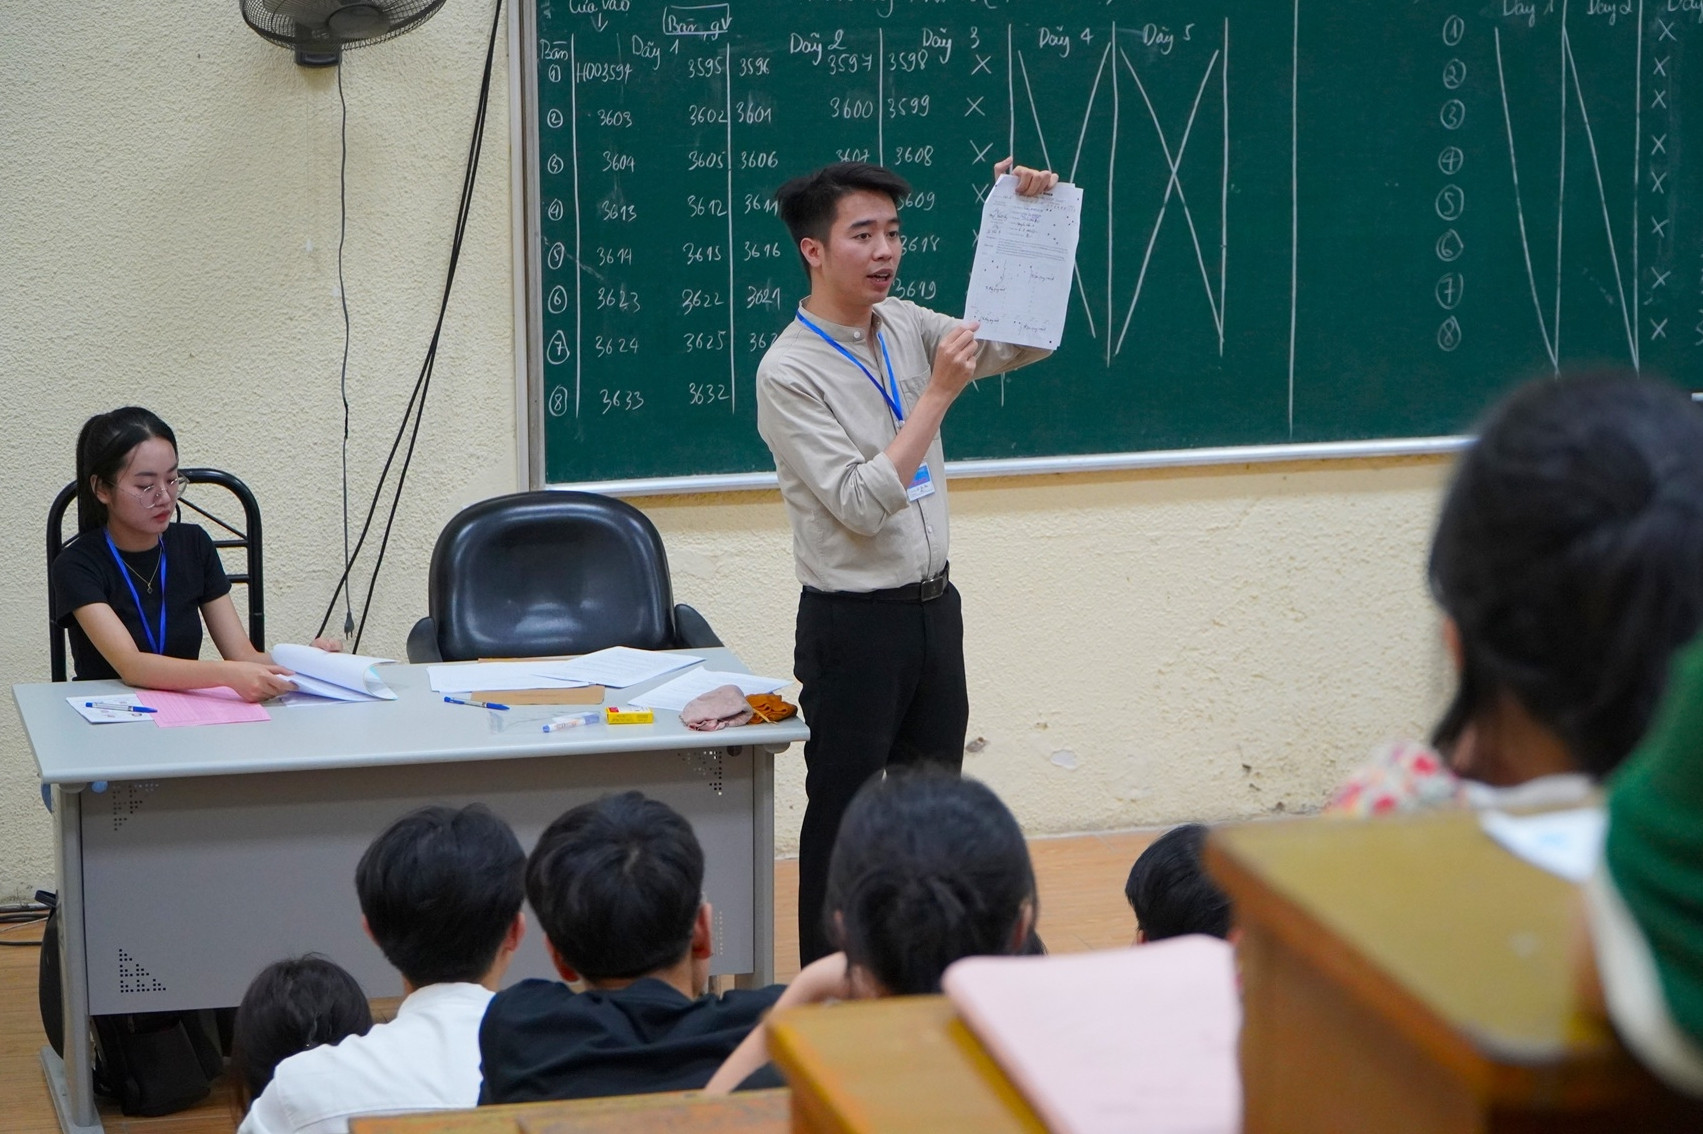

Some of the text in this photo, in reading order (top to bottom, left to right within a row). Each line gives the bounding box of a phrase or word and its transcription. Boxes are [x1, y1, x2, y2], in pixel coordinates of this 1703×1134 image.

[827, 29, 847, 50] 2
[969, 26, 981, 49] 3
[1080, 27, 1094, 46] 4
[1183, 23, 1196, 42] 5
[669, 39, 679, 54] 1
[688, 56, 723, 77] 3595
[739, 57, 770, 77] 3596
[828, 53, 873, 75] 3597
[889, 49, 928, 72] 3598
[689, 105, 728, 126] 3602
[736, 102, 772, 125] 3601
[830, 97, 874, 119] 3600
[888, 95, 930, 119] 3599
[597, 109, 632, 128] 3603
[688, 150, 726, 171] 3605
[741, 151, 778, 169] 3606
[895, 145, 934, 167] 3608
[601, 200, 637, 222] 3613
[687, 195, 727, 217] 3612
[744, 193, 778, 217] 3611
[597, 246, 632, 267] 3614
[682, 243, 721, 265] 3615
[744, 241, 781, 261] 3616
[892, 277, 936, 300] 3619
[597, 287, 641, 313] 3623
[682, 289, 724, 316] 3622
[595, 335, 639, 358] 3624
[683, 331, 726, 353] 3625
[600, 389, 644, 414] 3633
[689, 382, 730, 405] 3632
